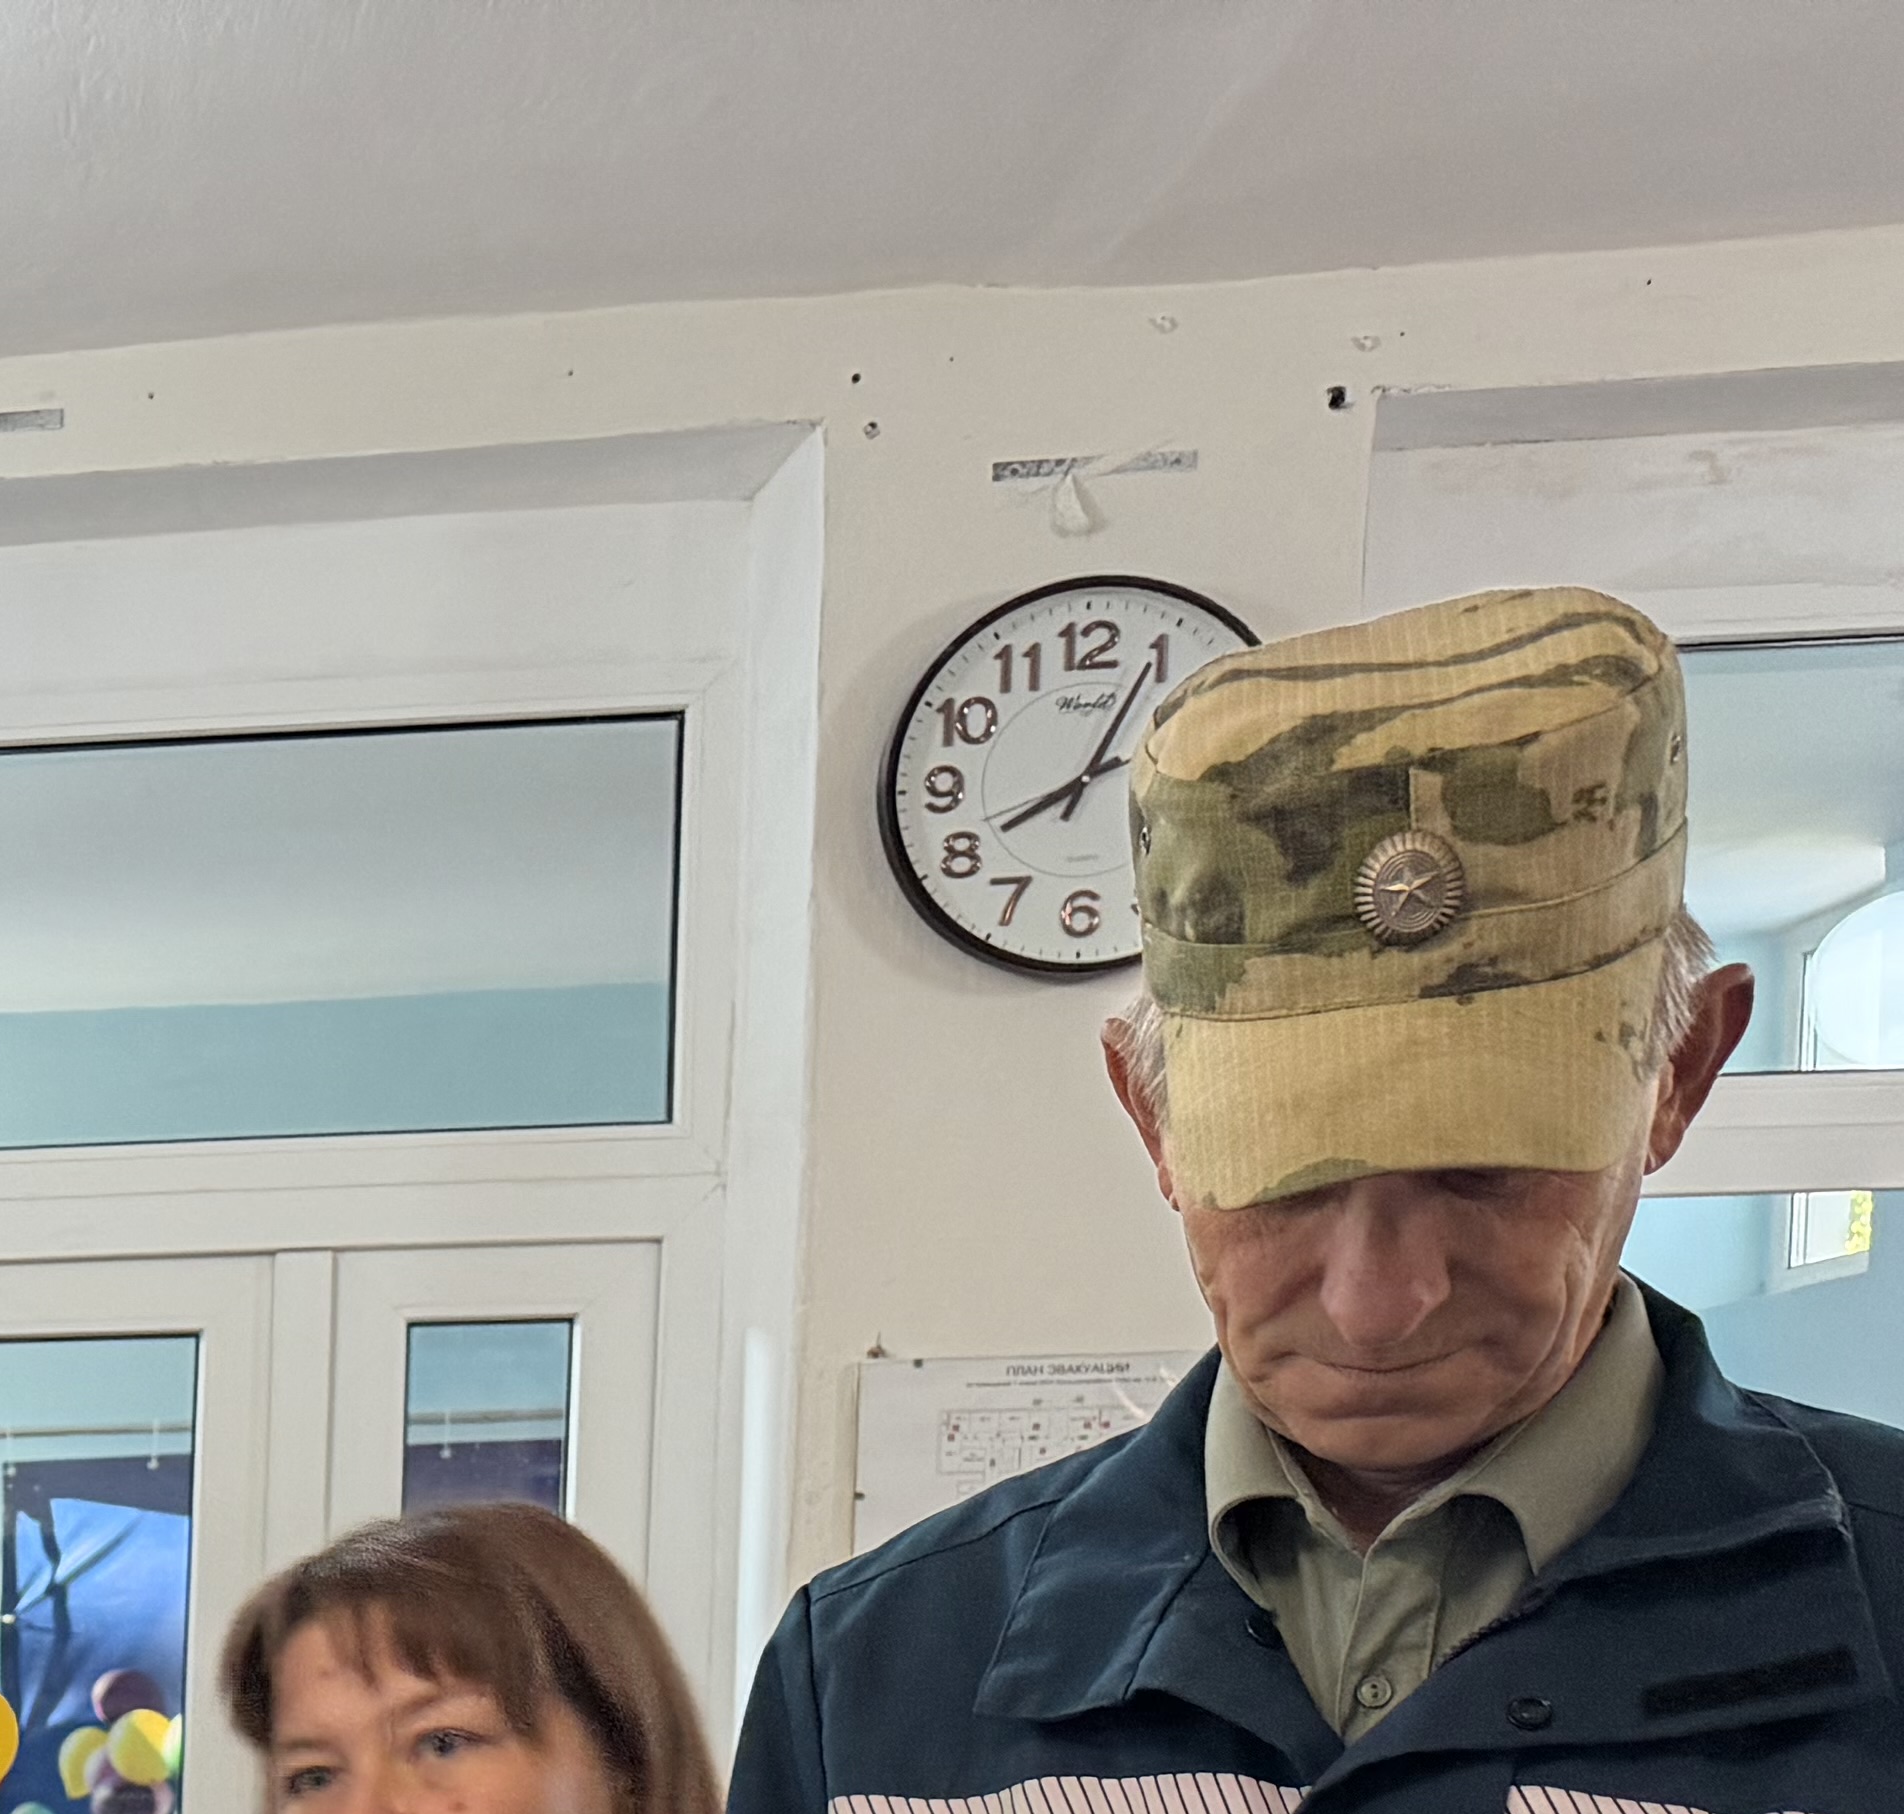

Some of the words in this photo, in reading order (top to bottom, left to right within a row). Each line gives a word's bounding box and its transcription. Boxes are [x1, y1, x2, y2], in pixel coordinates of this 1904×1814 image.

[993, 641, 1042, 694] 11
[1058, 620, 1121, 672] 12
[1148, 633, 1170, 684] 1
[936, 696, 998, 748] 10
[924, 765, 965, 814] 9
[941, 831, 982, 879] 8
[990, 875, 1033, 927] 7
[1060, 889, 1101, 938] 6
